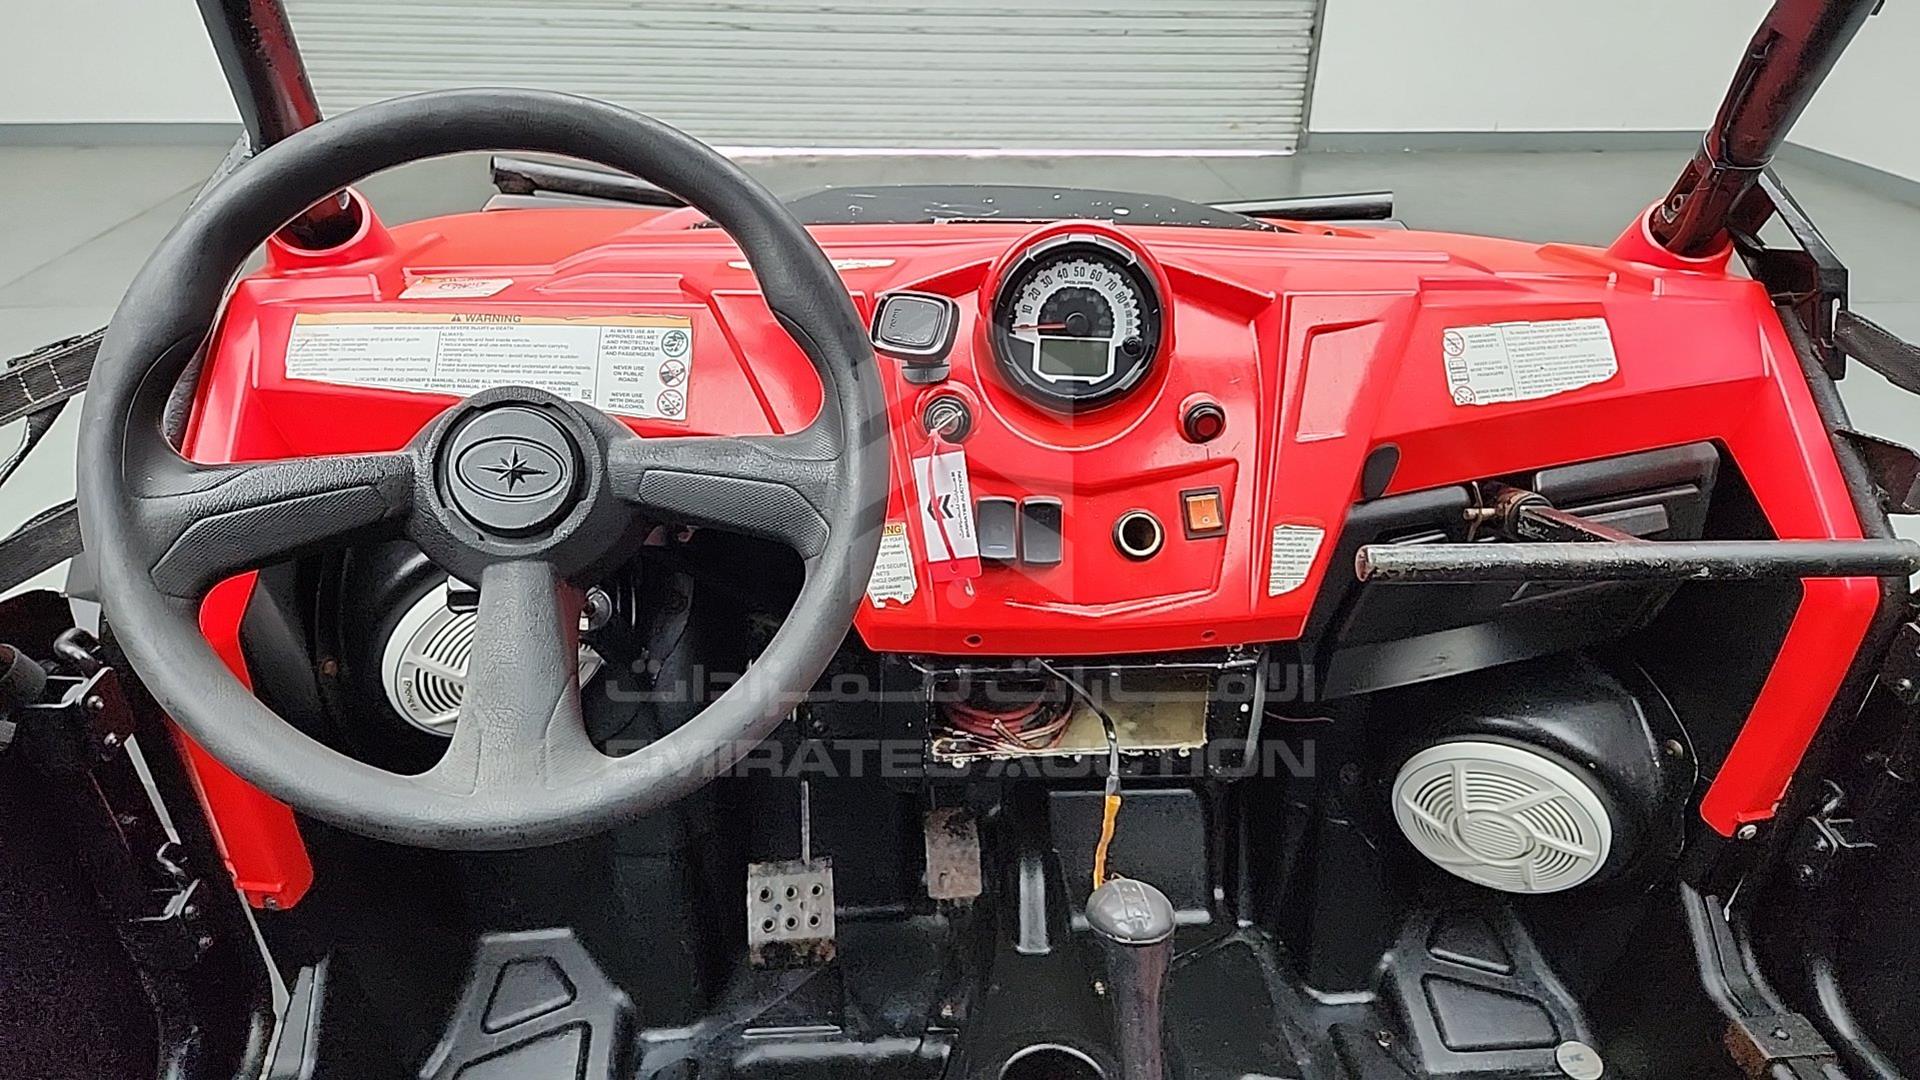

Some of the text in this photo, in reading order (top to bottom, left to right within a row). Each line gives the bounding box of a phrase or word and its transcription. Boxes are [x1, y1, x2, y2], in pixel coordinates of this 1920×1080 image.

[1057, 267, 1069, 280] 40
[1074, 266, 1085, 277] 50
[1090, 269, 1102, 281] 60
[1041, 275, 1053, 288] 30
[1105, 278, 1117, 291] 70
[1028, 288, 1041, 301] 20
[1114, 291, 1128, 304] 80
[1022, 304, 1033, 314] 10
[465, 314, 522, 323] WARNING
[957, 471, 966, 502] AUCTION
